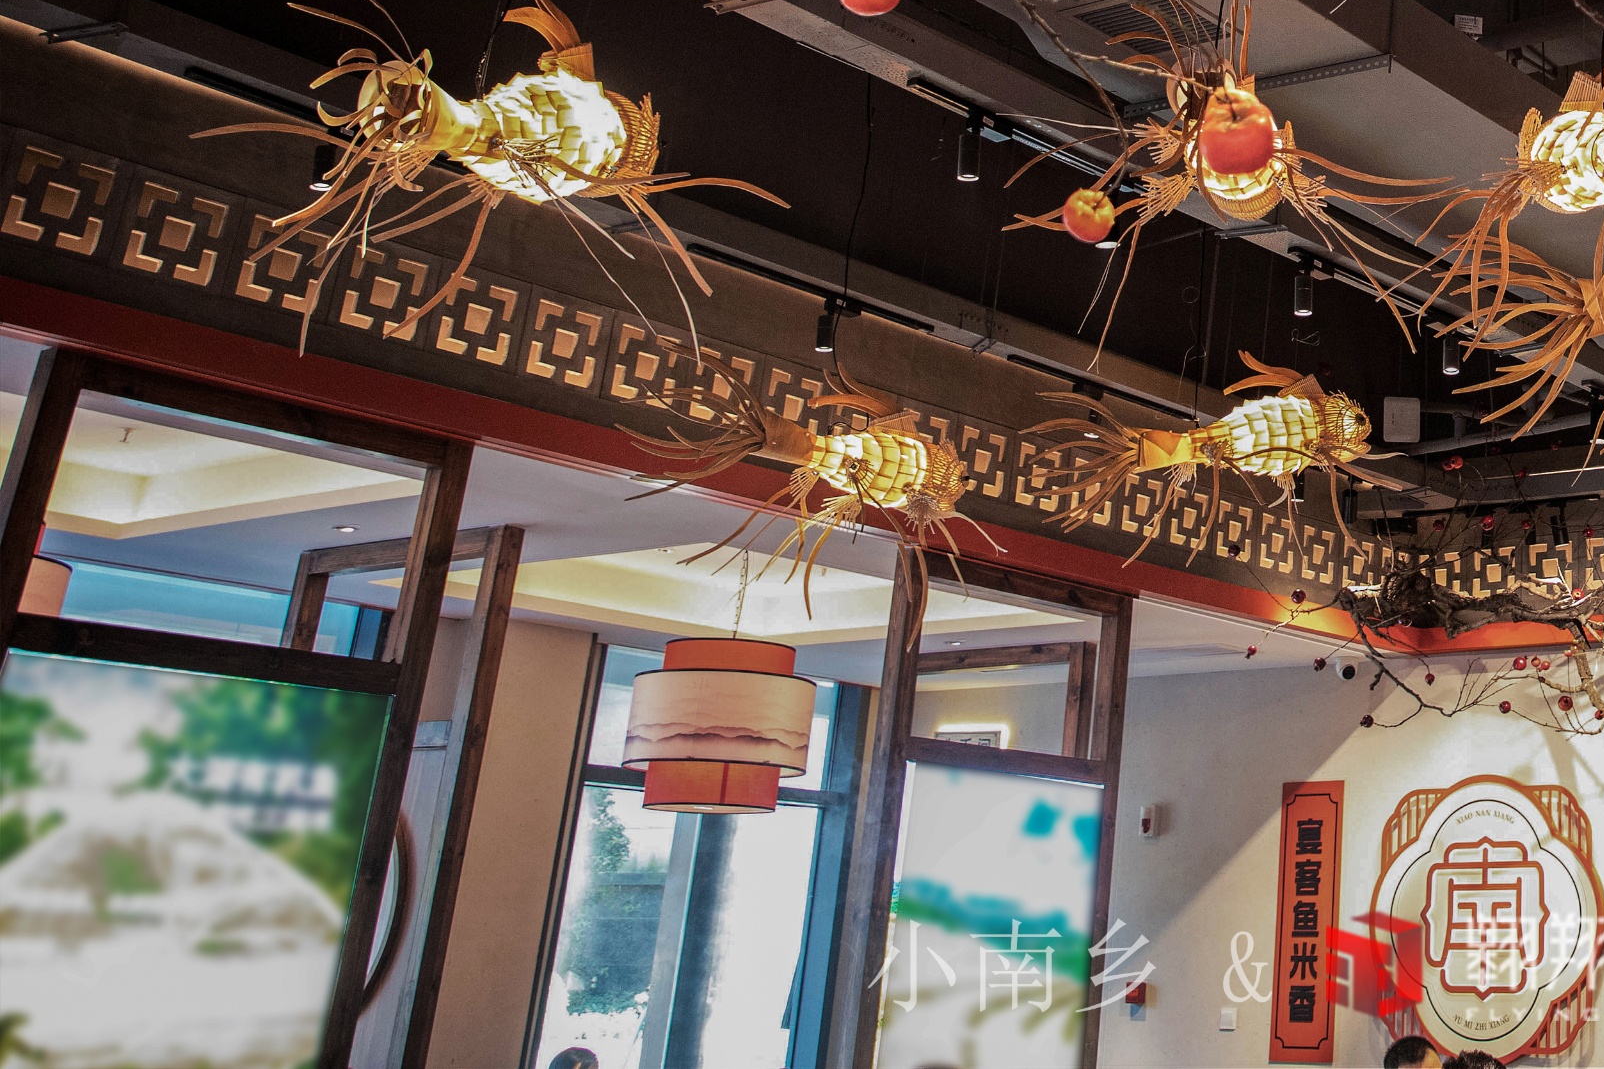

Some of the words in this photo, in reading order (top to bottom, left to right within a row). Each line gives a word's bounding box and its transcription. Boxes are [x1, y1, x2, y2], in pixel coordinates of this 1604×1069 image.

[1456, 812, 1473, 825] XIAO
[1475, 809, 1491, 818] NAN
[1493, 810, 1514, 824] XIANG
[1288, 818, 1324, 1023] 宴客鱼米香
